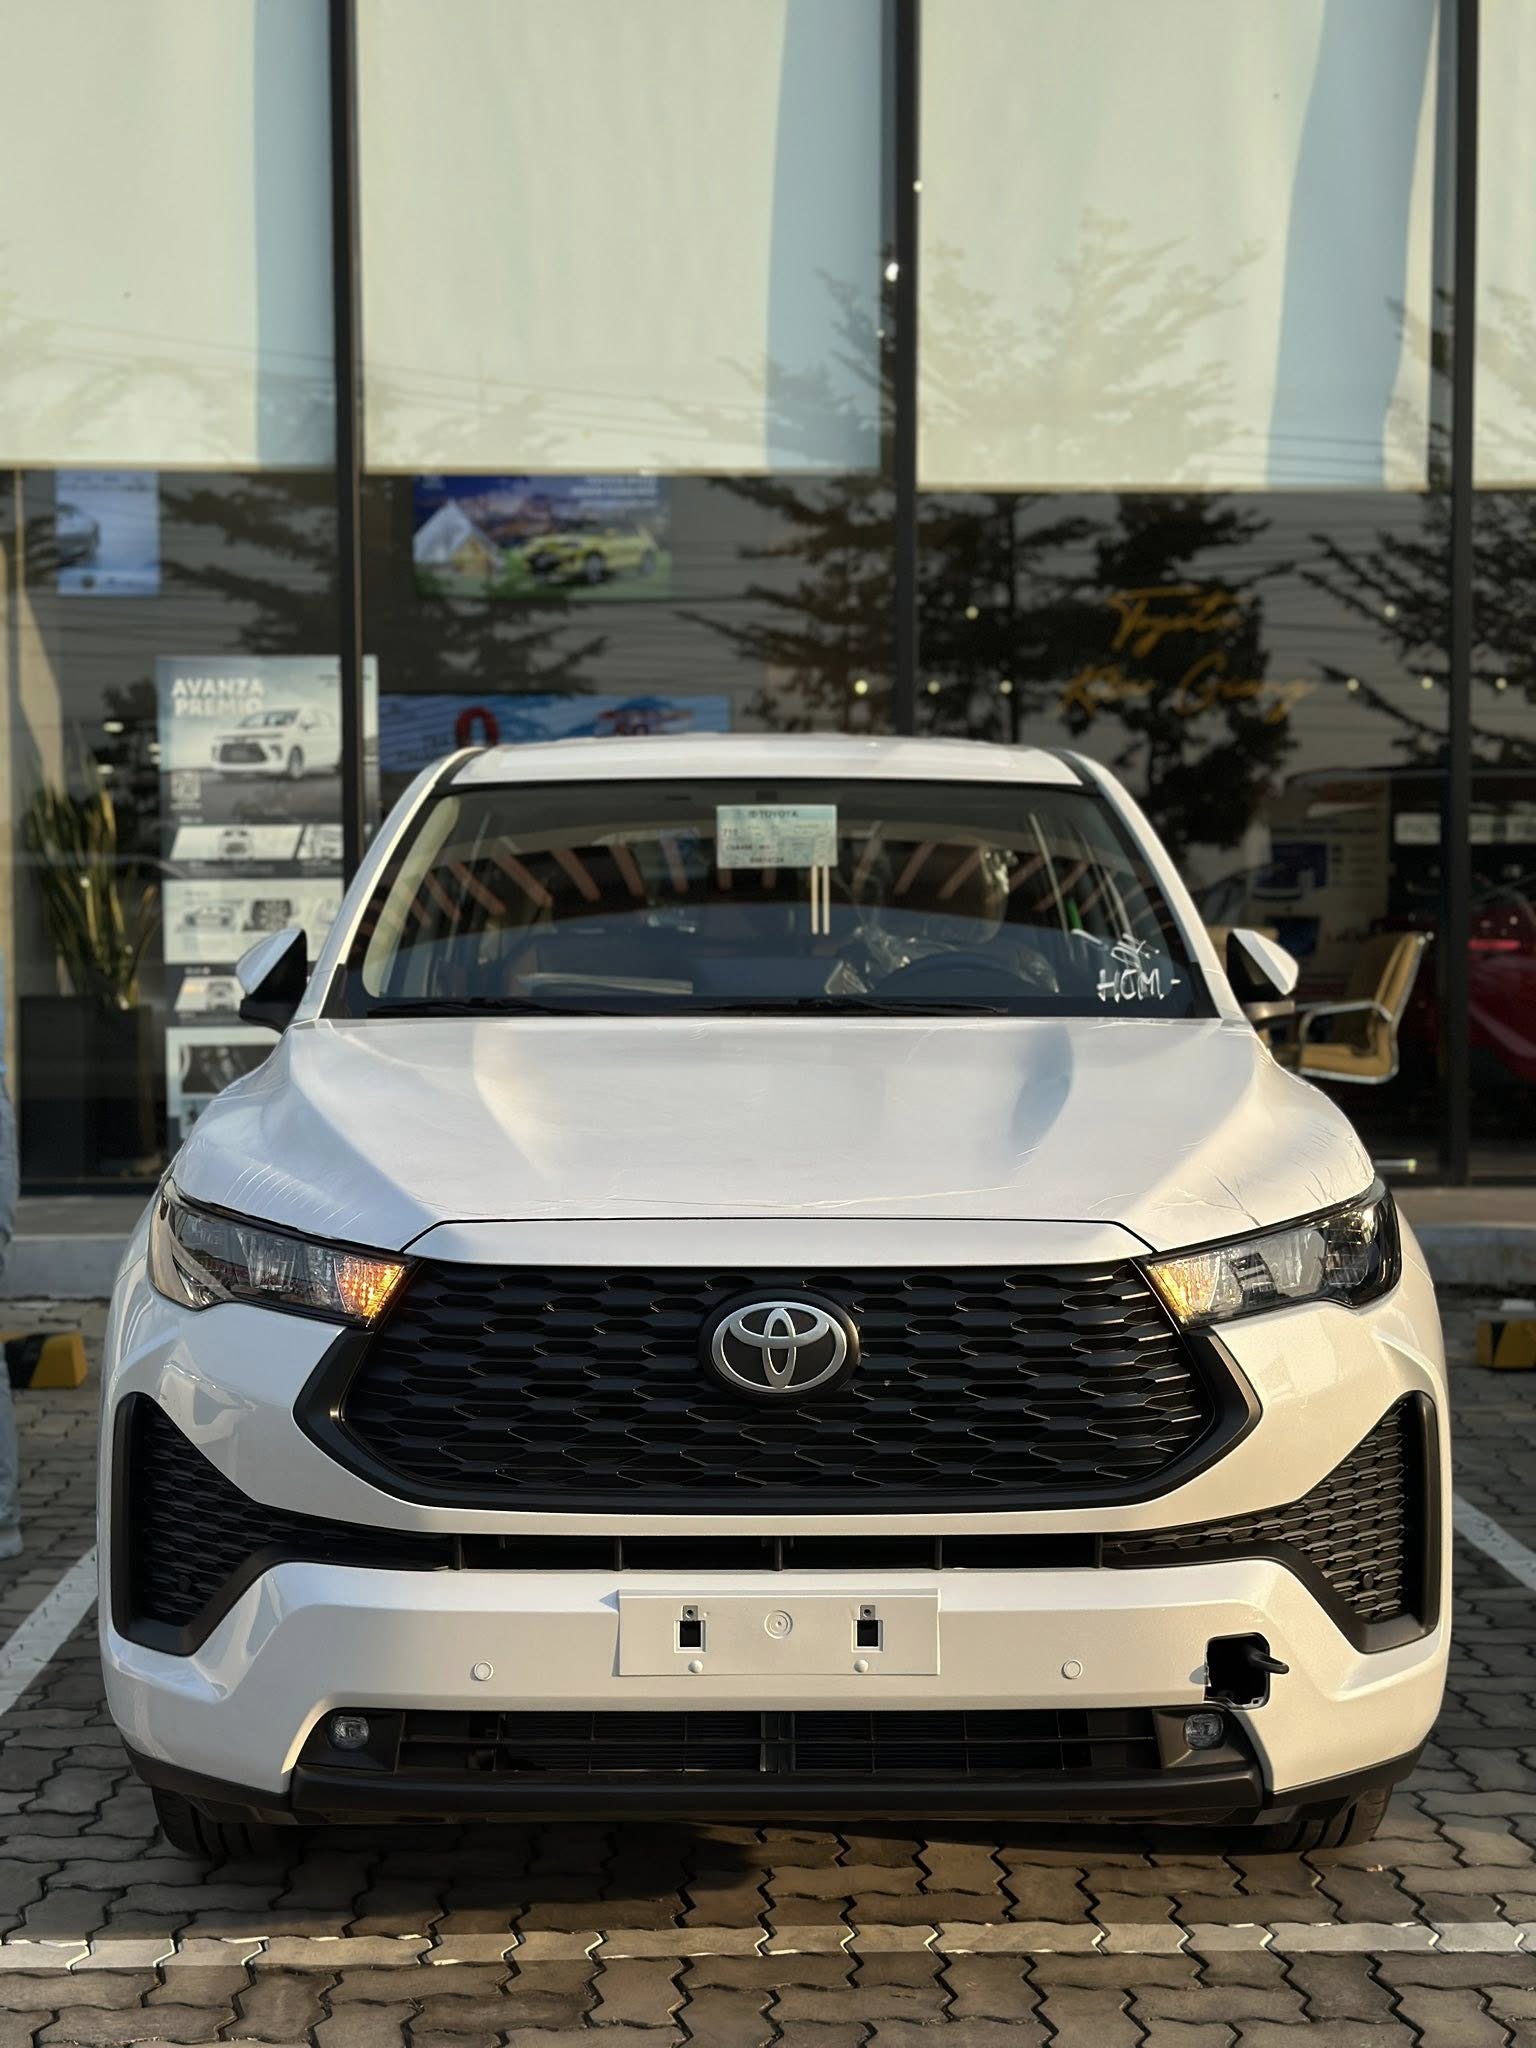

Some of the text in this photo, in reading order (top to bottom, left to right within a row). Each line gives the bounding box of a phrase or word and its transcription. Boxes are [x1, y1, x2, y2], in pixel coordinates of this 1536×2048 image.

[1104, 584, 1254, 657] Toyota
[172, 678, 265, 697] AVANZA
[760, 810, 800, 819] TOYOTA
